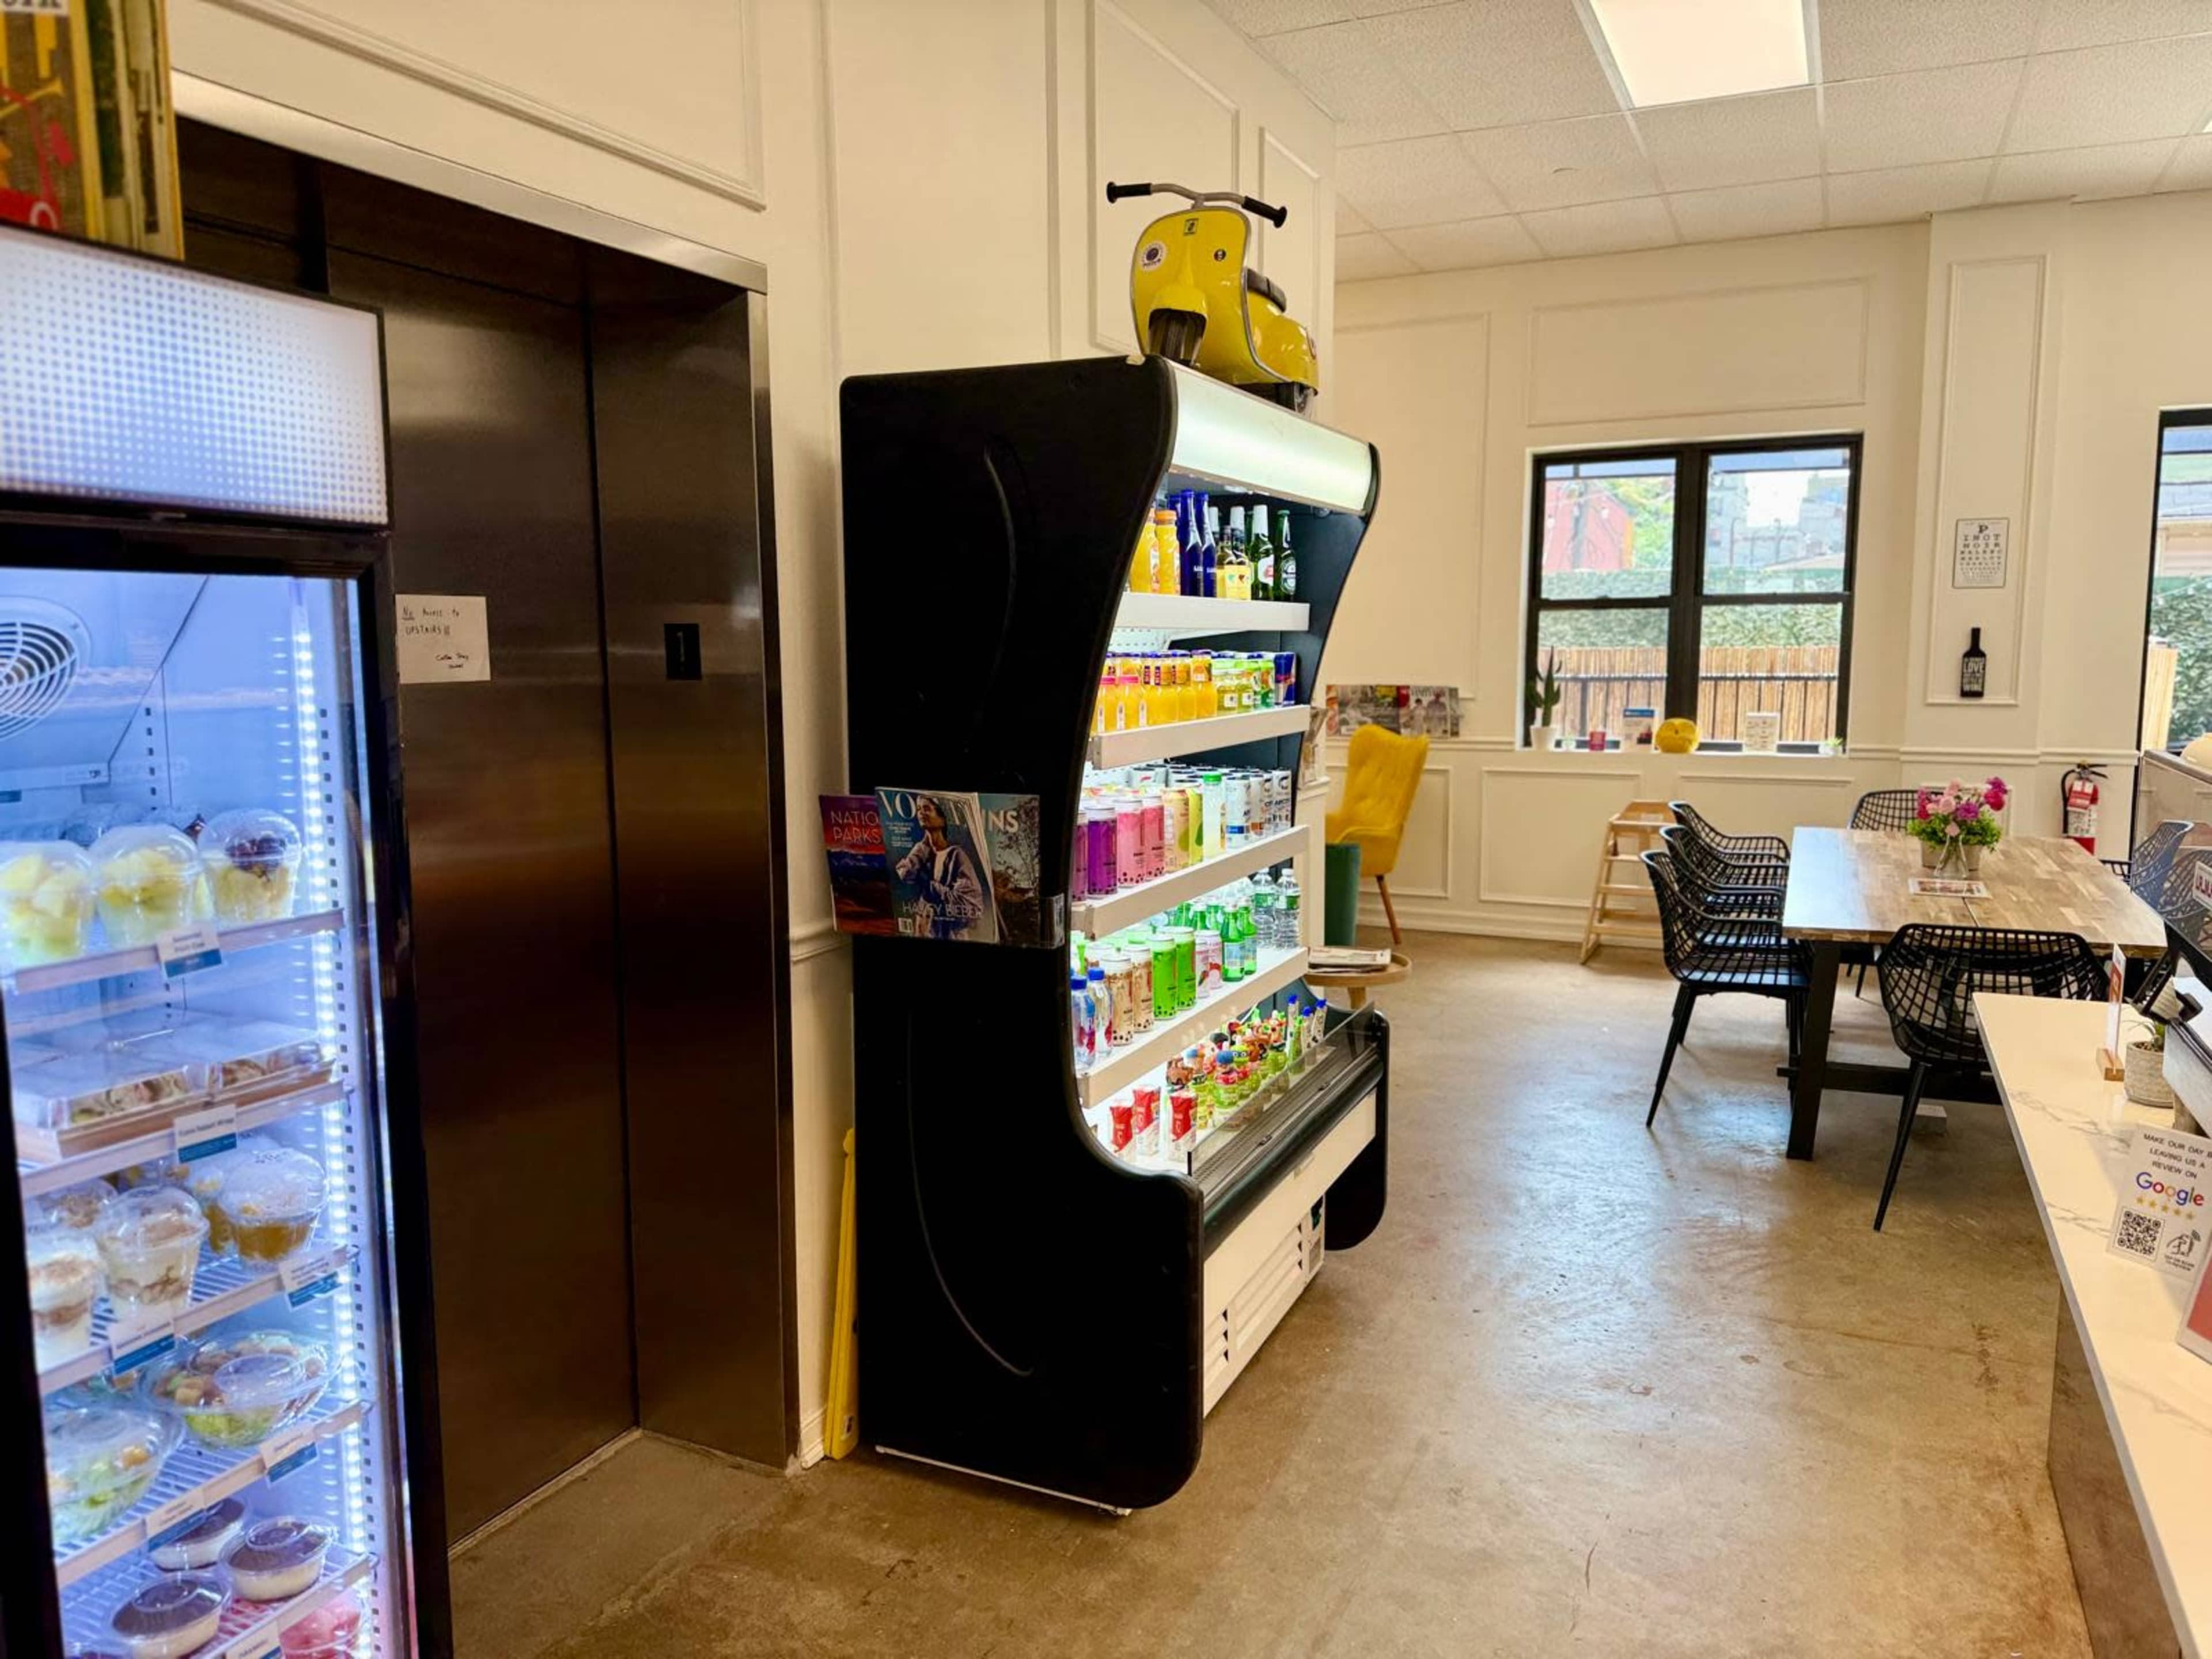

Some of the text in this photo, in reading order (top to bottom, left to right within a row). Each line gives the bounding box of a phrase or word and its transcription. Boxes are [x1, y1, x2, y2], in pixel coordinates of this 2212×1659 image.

[832, 826, 882, 844] PARKS
[2143, 1133, 2164, 1144] MAKE
[2168, 1140, 2185, 1150] OUR
[2188, 1146, 2204, 1155] DAY
[2149, 1147, 2183, 1162] LEAVING
[2185, 1158, 2196, 1166] US
[2152, 1160, 2198, 1179] REVIEW ON
[2135, 1172, 2205, 1206] Google
